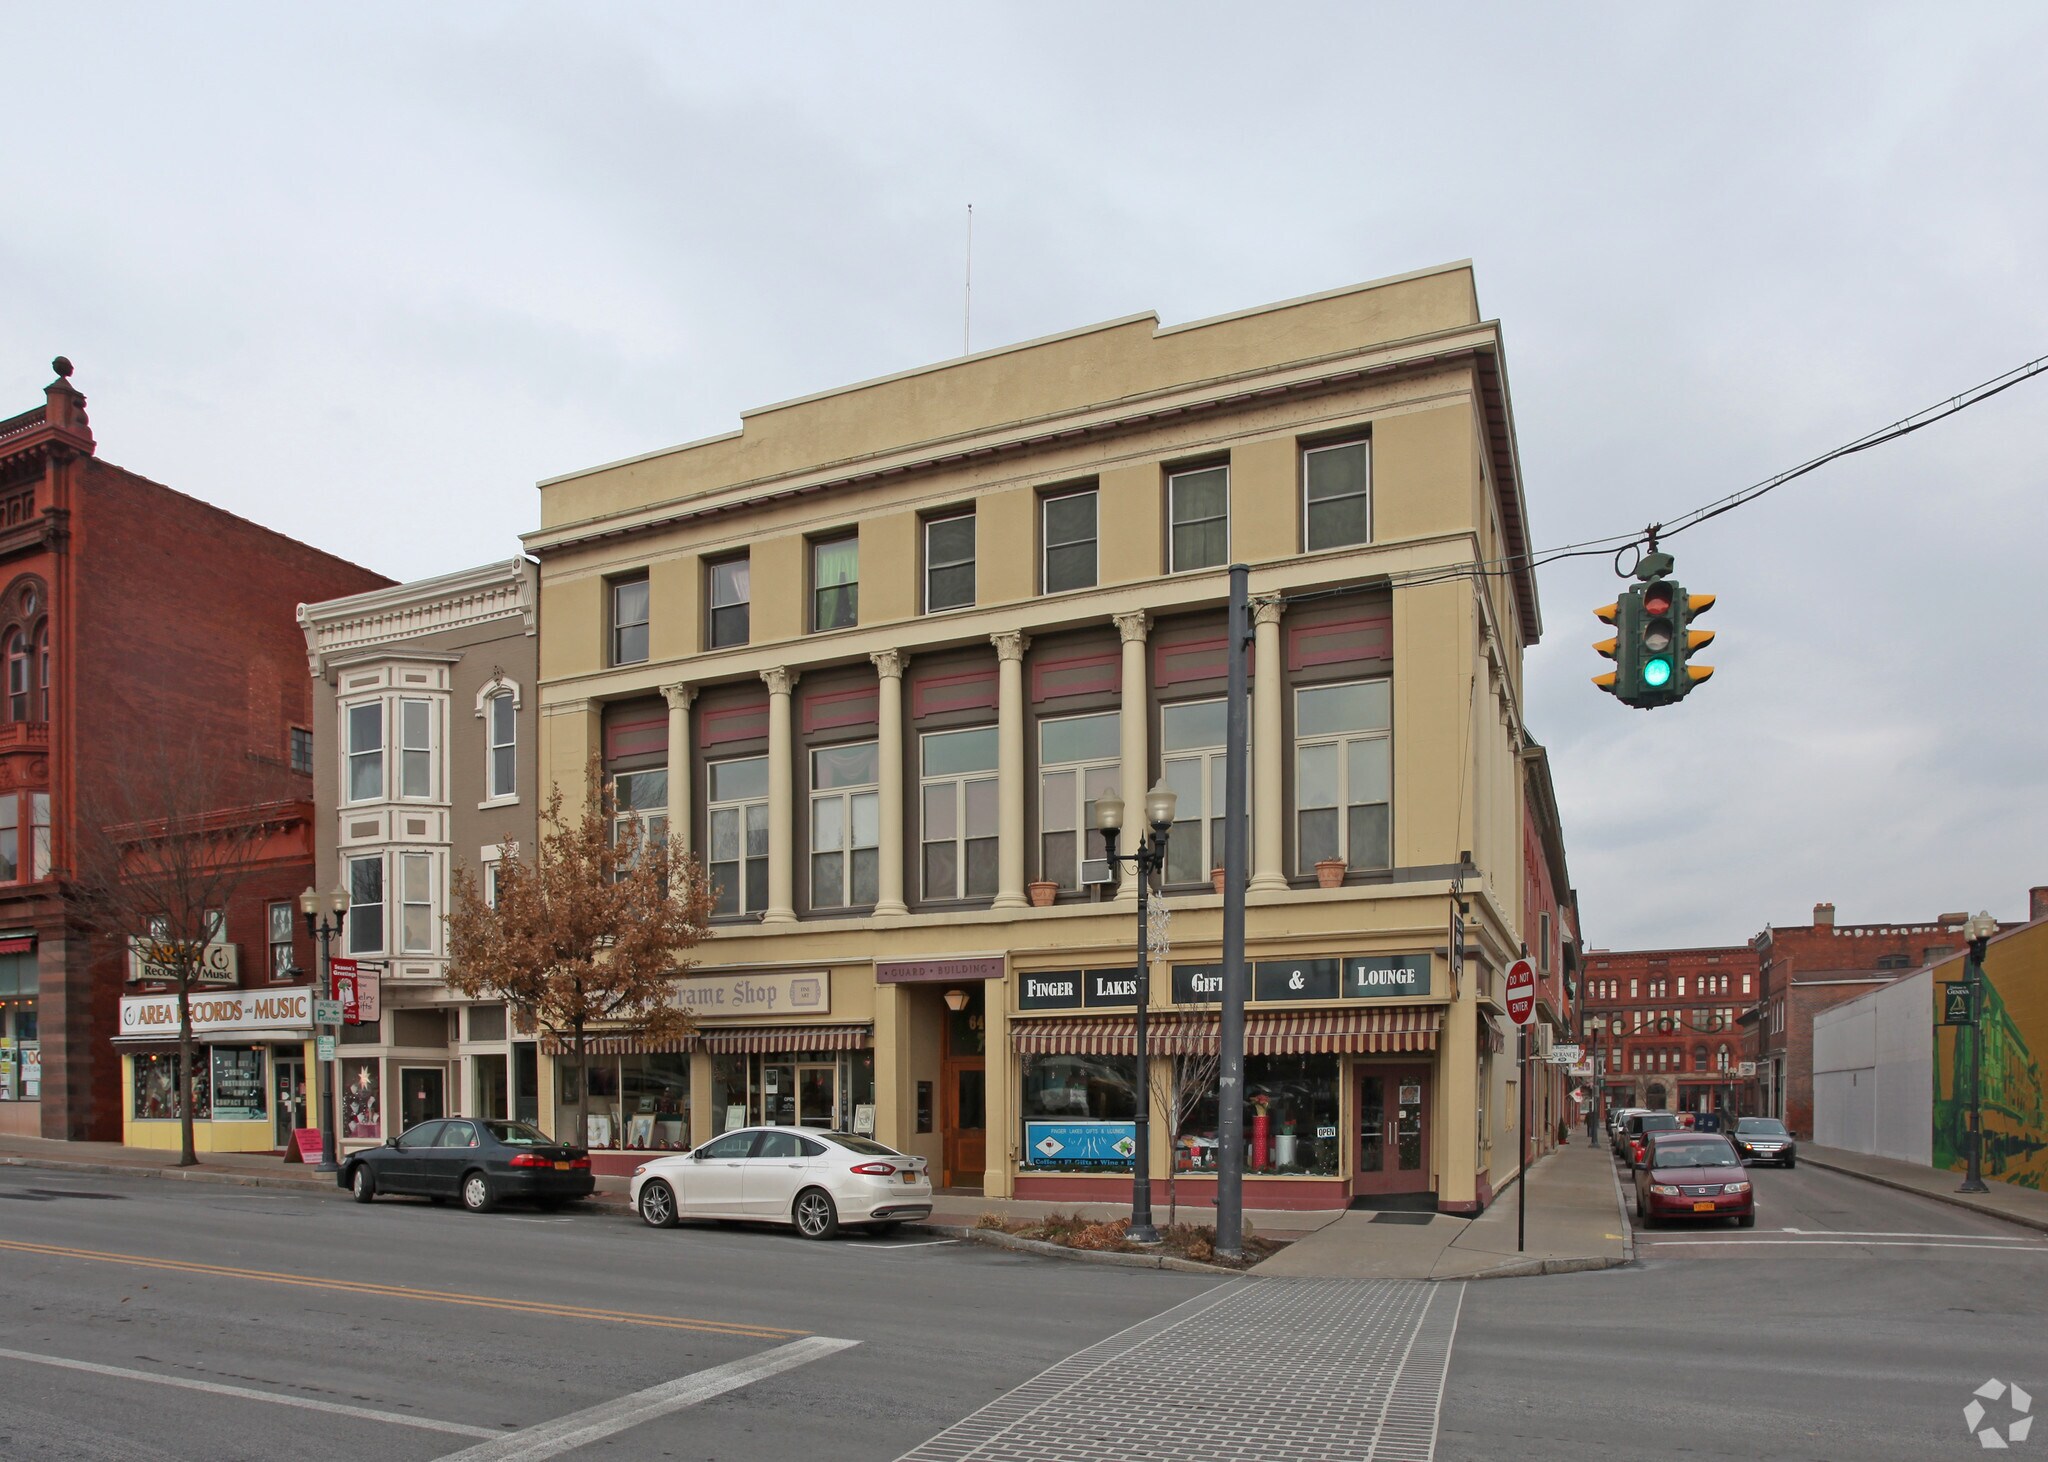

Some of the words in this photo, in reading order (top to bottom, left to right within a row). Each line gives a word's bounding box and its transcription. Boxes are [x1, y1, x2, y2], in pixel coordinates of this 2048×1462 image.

[203, 968, 232, 980] Music
[333, 970, 357, 978] Greetings
[891, 967, 926, 977] GUARD
[938, 964, 988, 975] BUILDING
[1027, 979, 1074, 998] FINGER
[1097, 977, 1137, 996] LAKES
[1191, 973, 1223, 993] GIFT
[1288, 970, 1305, 990] &
[1357, 966, 1415, 986] LOUNGE
[1509, 975, 1516, 986] DO
[1519, 972, 1530, 983] NOT
[358, 992, 375, 1003] elry
[732, 980, 778, 1010] Shop
[138, 1004, 173, 1025] AREA
[244, 1006, 253, 1014] and
[254, 996, 307, 1019] MUSIC
[360, 1003, 373, 1012] ifts
[1512, 1001, 1529, 1013] ENTER
[317, 1009, 340, 1022] PARKING
[1318, 1128, 1335, 1136] OPEN
